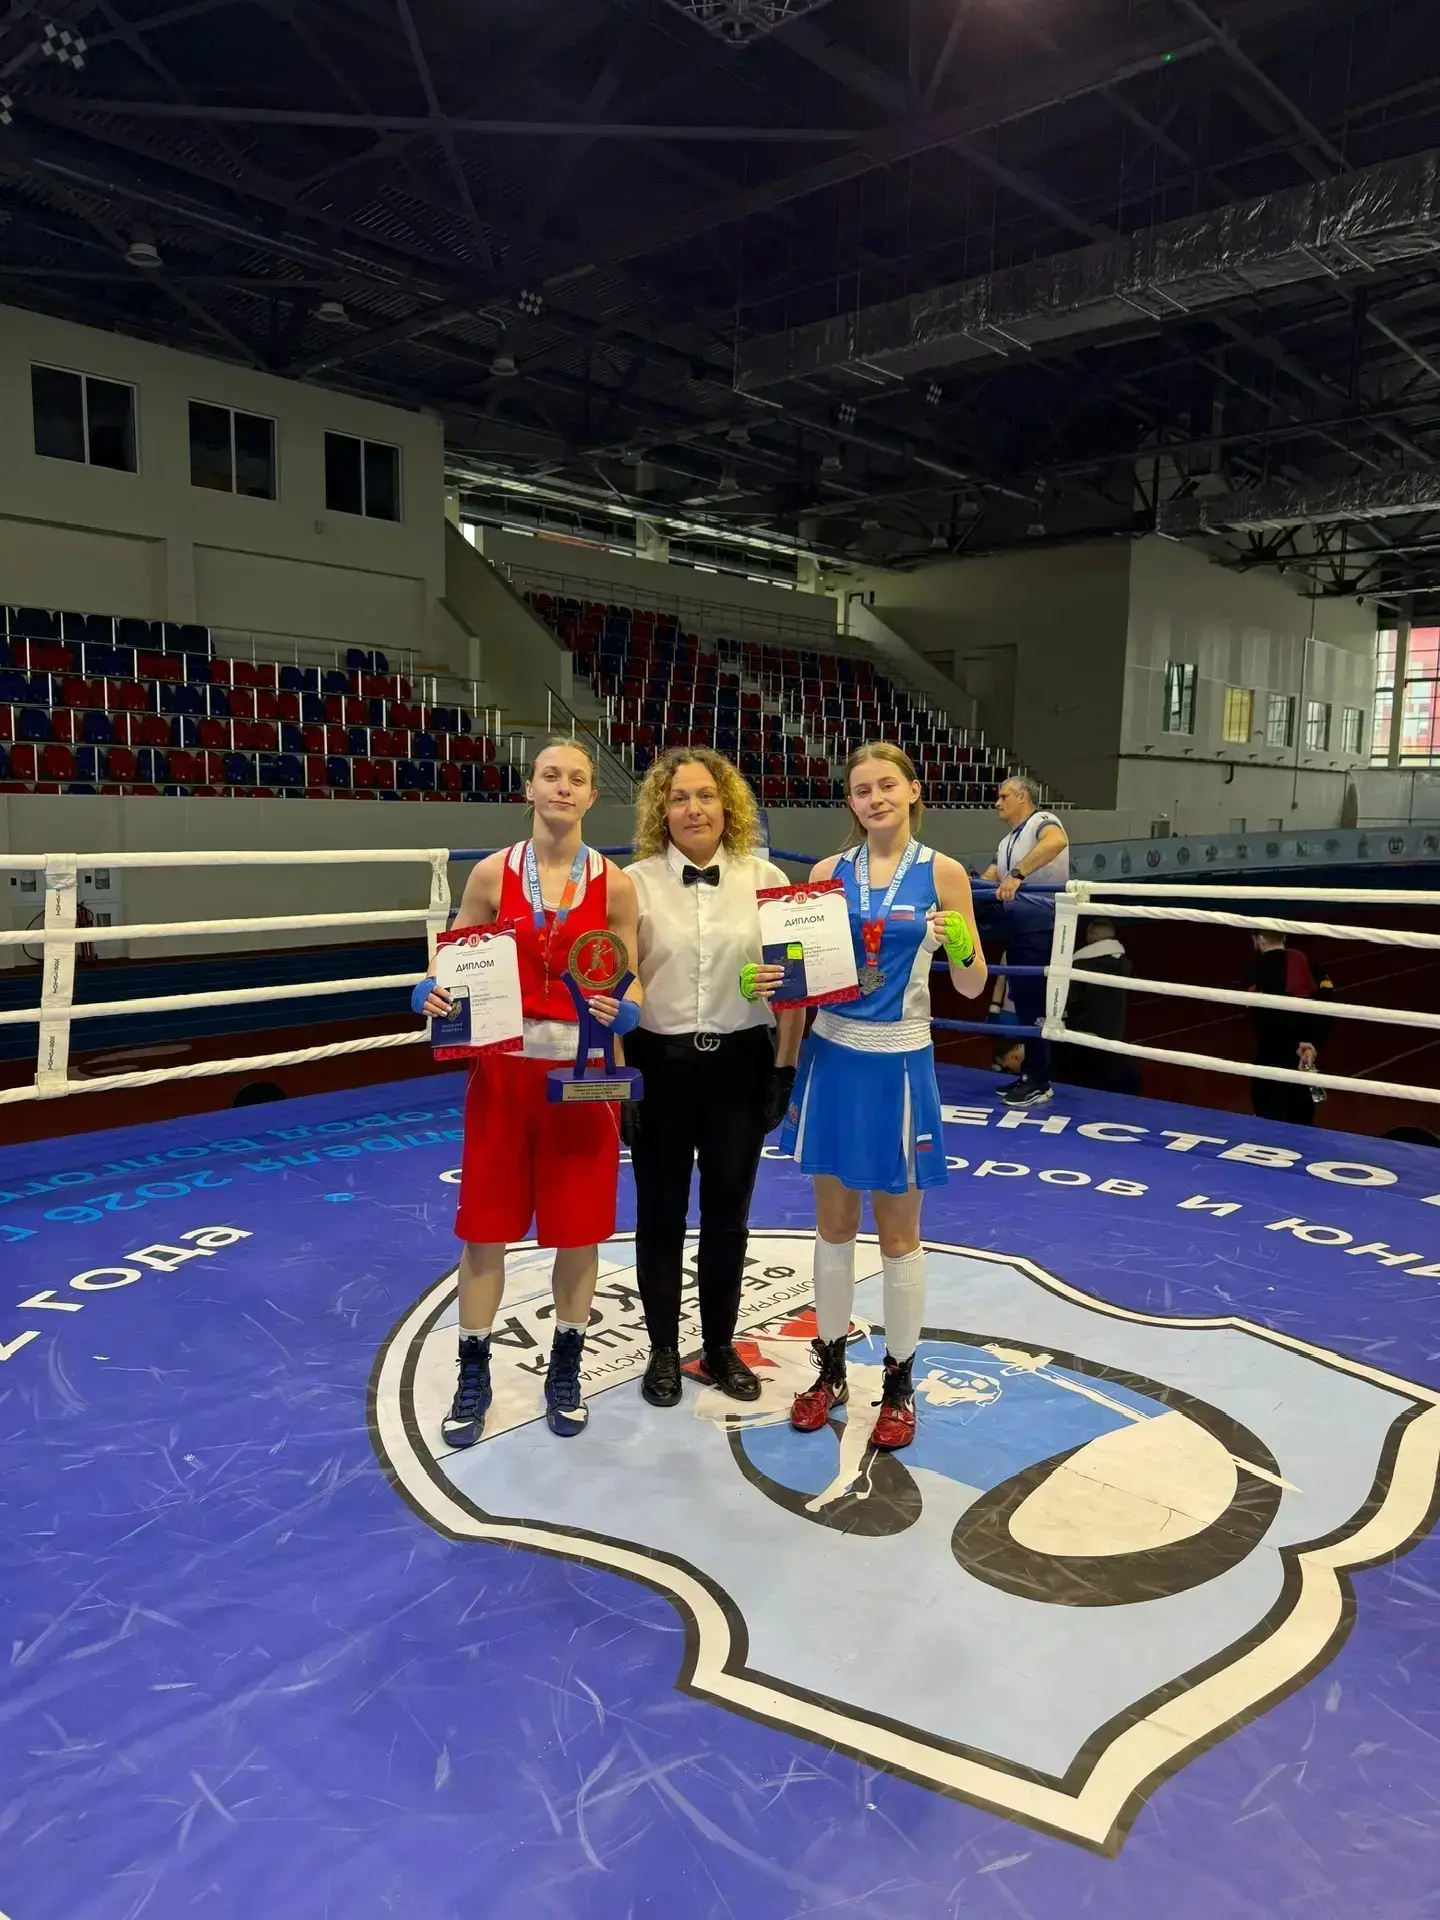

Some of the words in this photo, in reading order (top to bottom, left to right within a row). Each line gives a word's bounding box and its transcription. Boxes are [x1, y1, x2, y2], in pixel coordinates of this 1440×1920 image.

[784, 915, 825, 928] ДИПЛОМ
[456, 959, 495, 973] ДИПЛОМ
[43, 1169, 233, 1224] 2026
[1176, 1194, 1243, 1217] и
[16, 1226, 254, 1312] года
